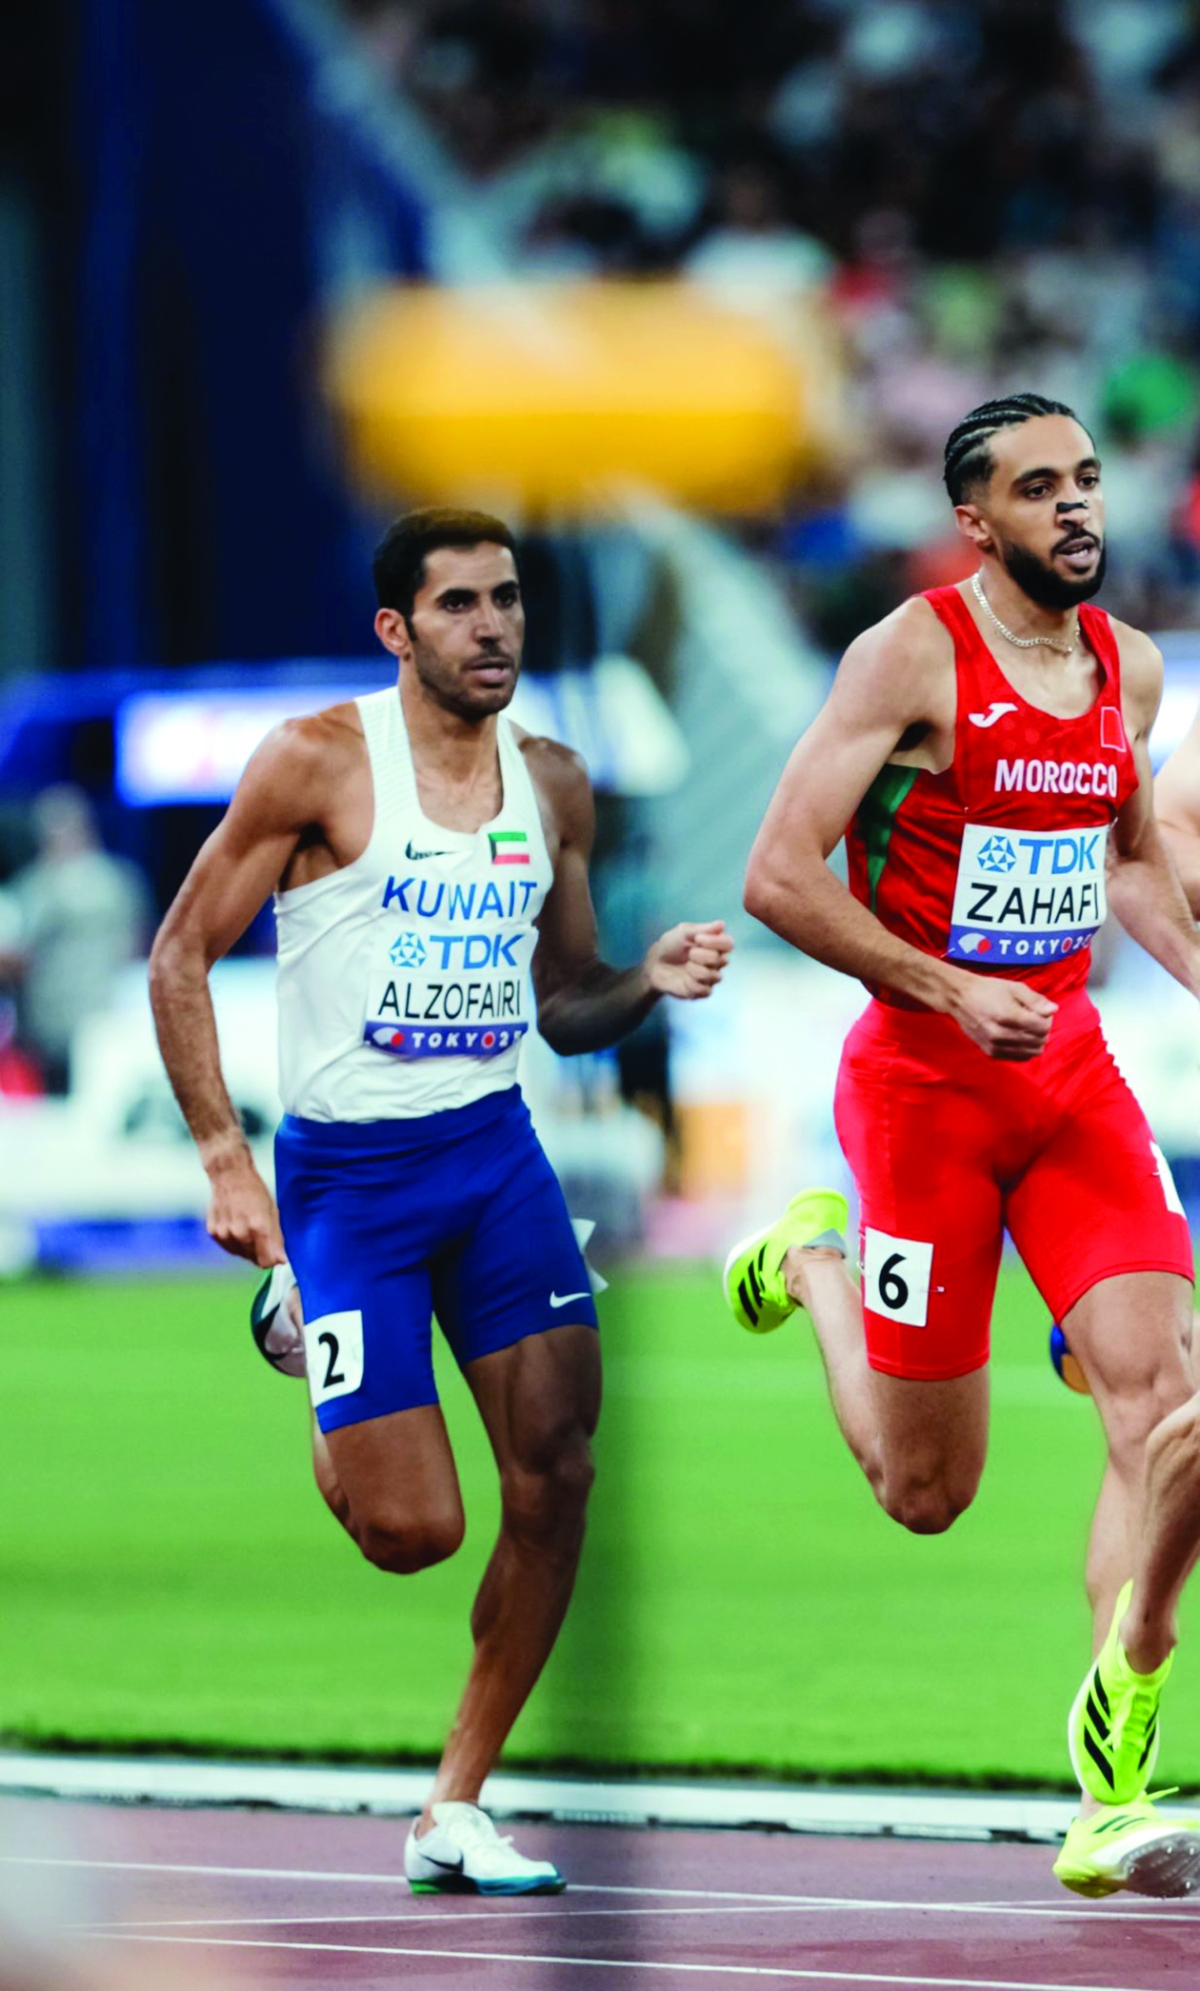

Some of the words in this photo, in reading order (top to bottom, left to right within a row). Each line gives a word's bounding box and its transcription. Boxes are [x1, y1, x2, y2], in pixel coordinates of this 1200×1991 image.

[994, 759, 1117, 797] MOROCCO
[1018, 834, 1100, 875] TDK
[382, 875, 537, 920] KUWAIT
[967, 882, 1099, 924] ZAHAFI
[429, 934, 525, 970] TDK
[378, 980, 520, 1019] ALZOFAIRI
[878, 1252, 909, 1310] 6
[318, 1332, 345, 1389] 2
